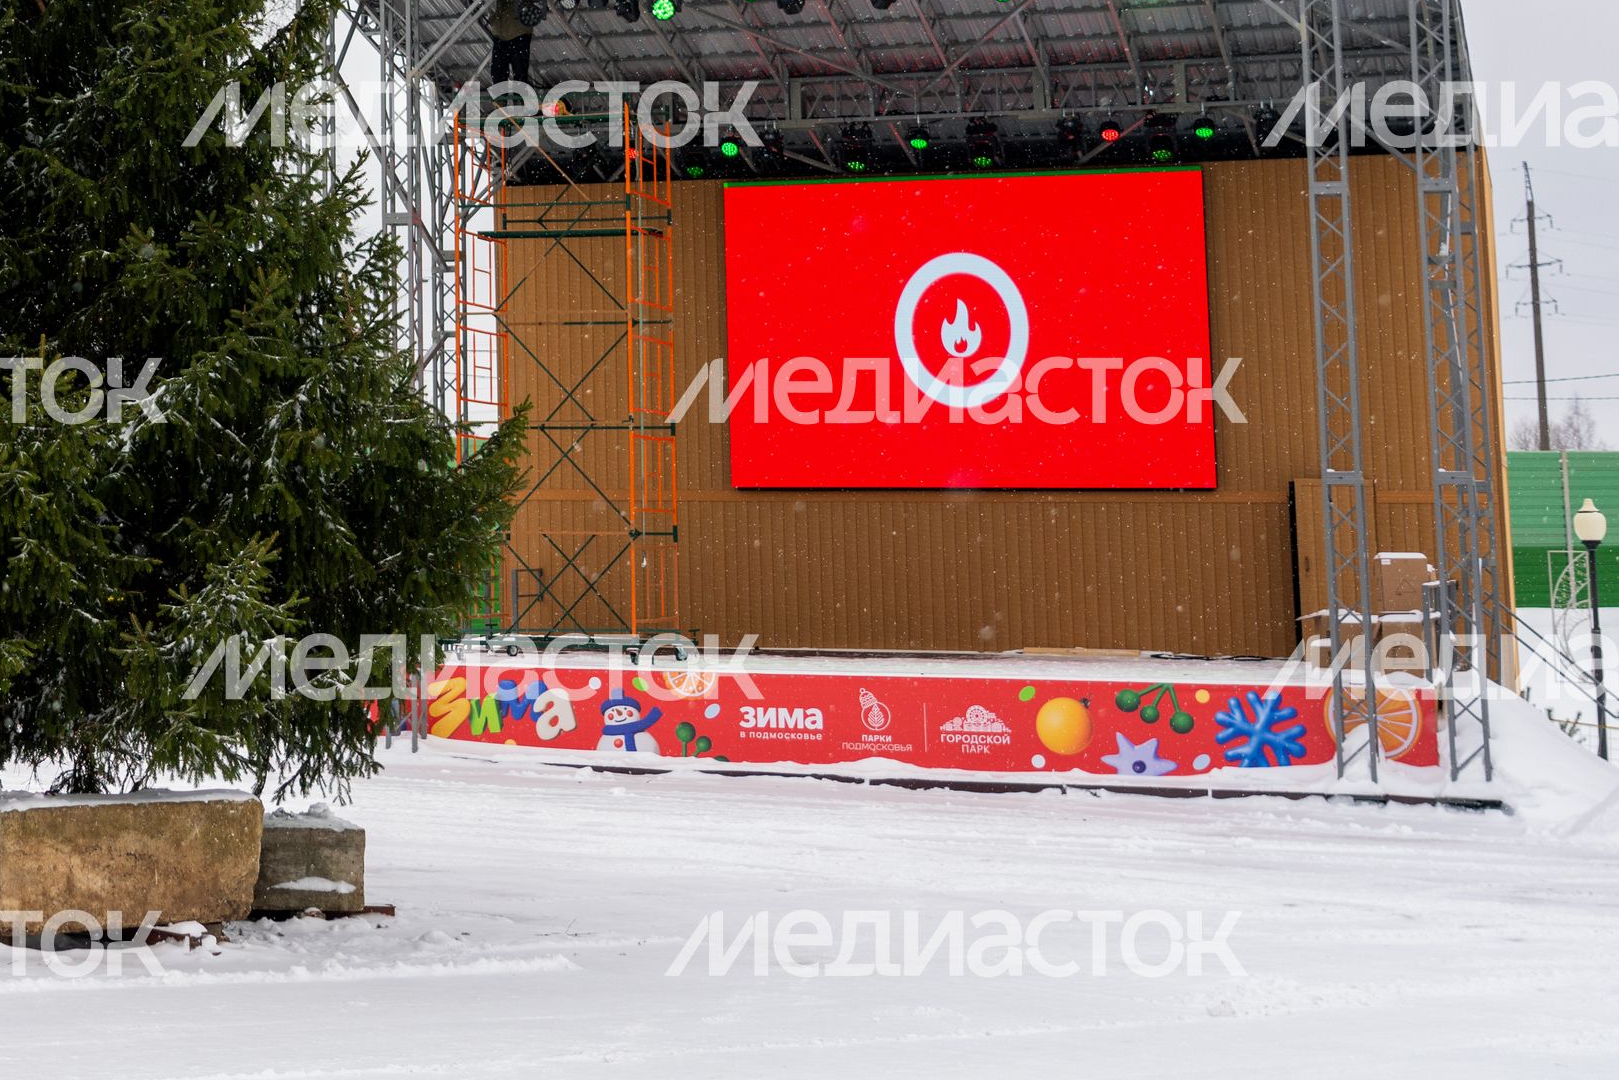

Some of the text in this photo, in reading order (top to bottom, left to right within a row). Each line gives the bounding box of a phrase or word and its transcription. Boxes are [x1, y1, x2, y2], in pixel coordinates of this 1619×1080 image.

[861, 734, 892, 743] ПАРКИ
[940, 733, 1011, 745] ГОРОДСКОЙ
[961, 744, 990, 755] ПАРК
